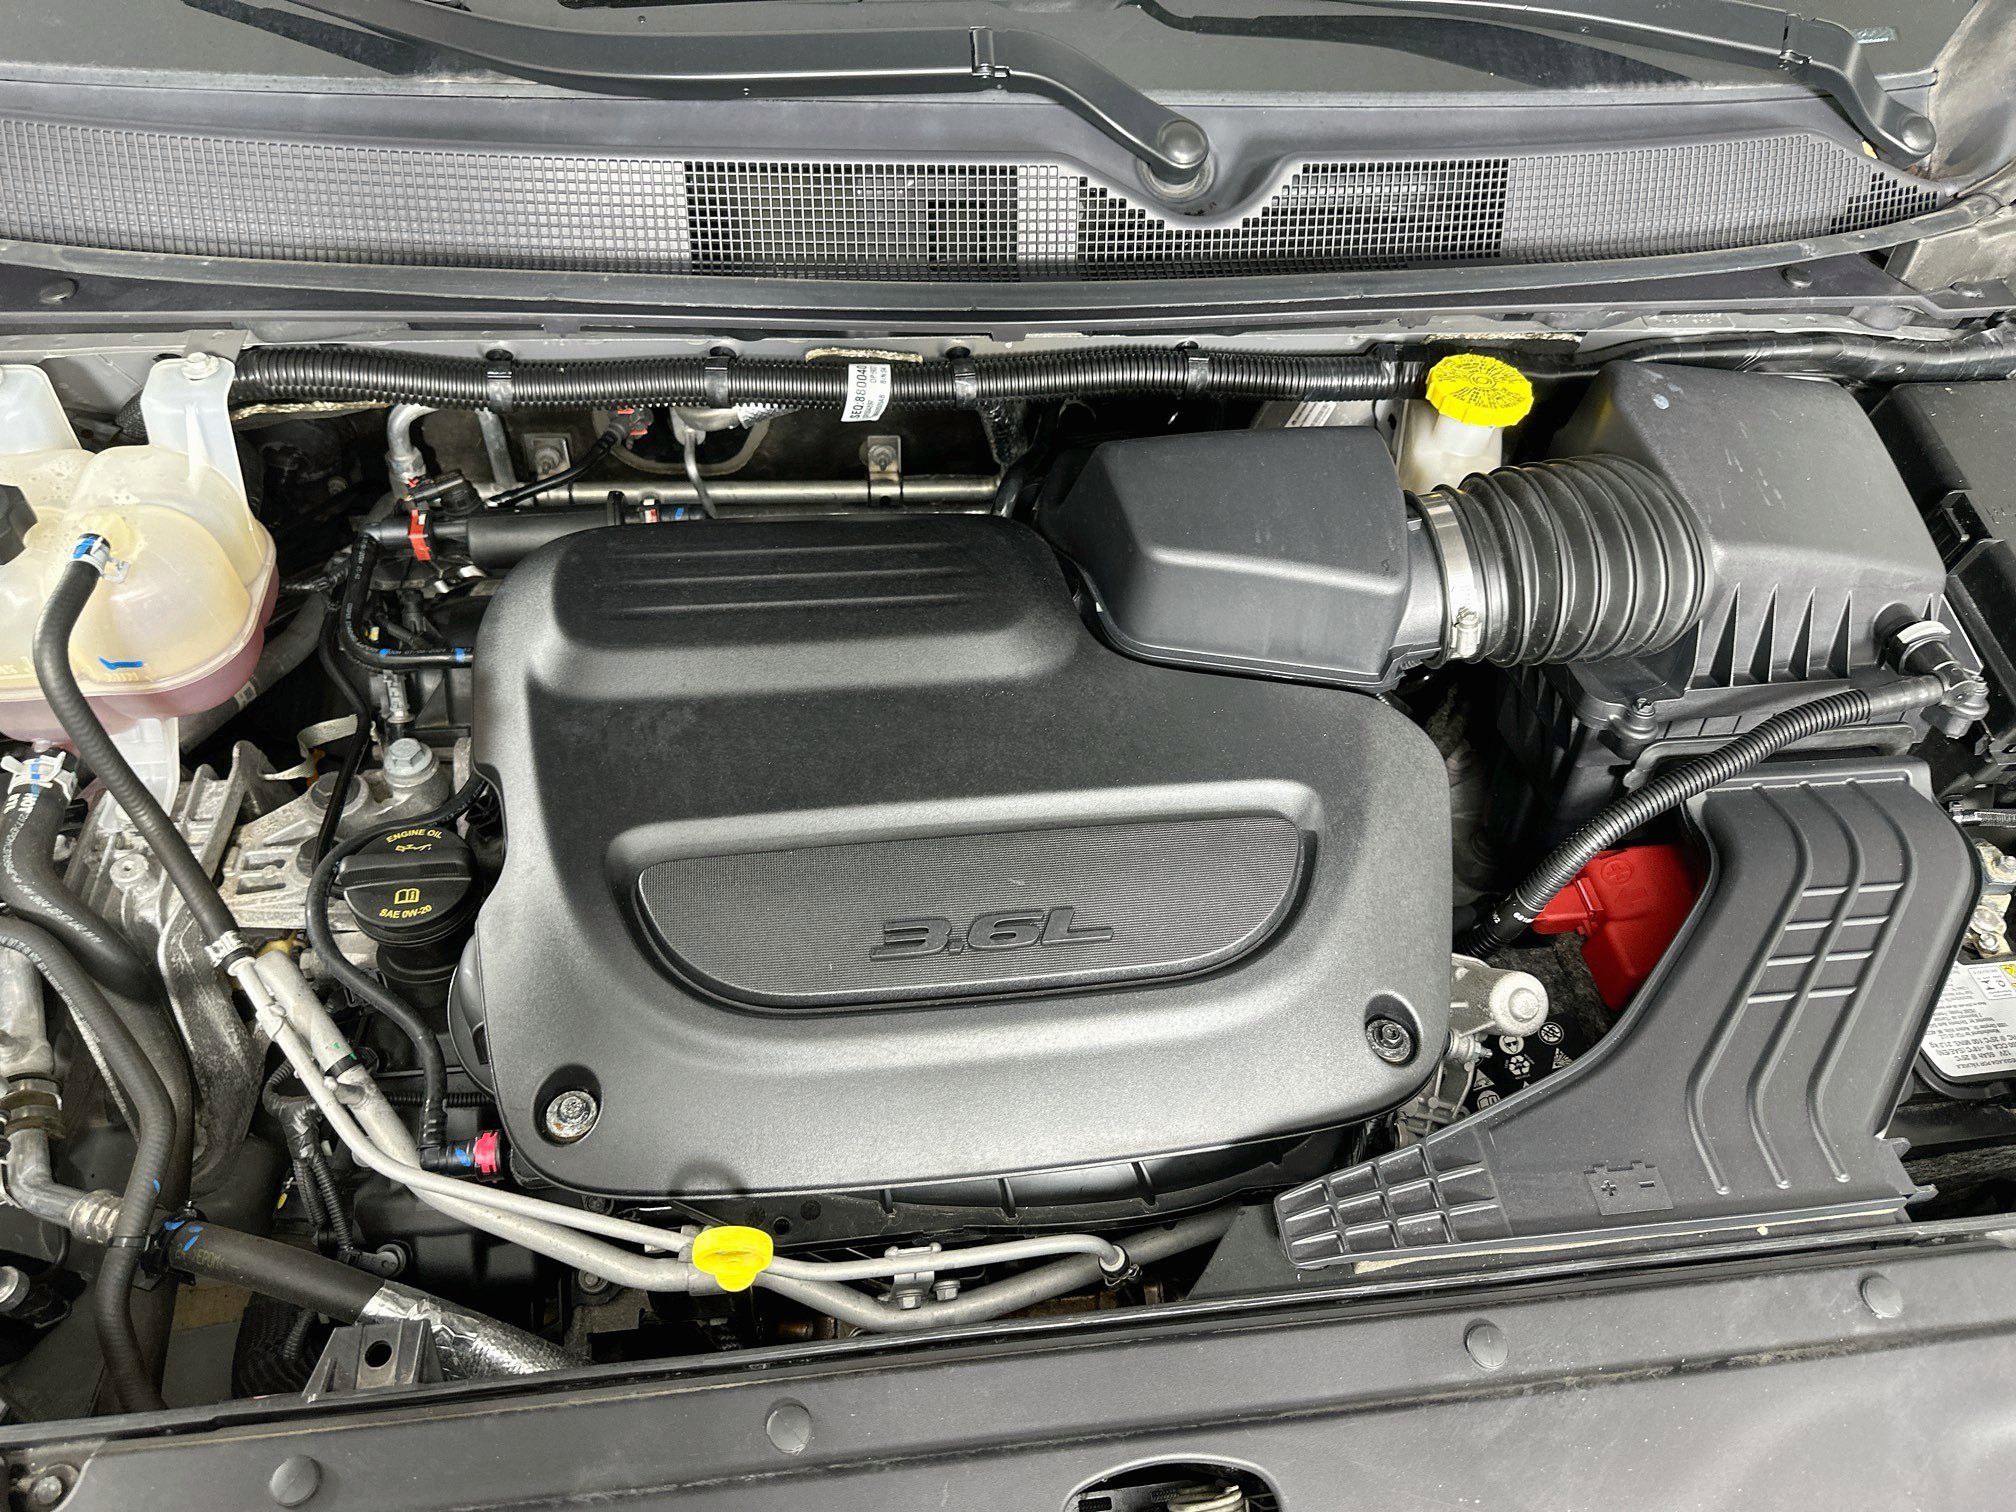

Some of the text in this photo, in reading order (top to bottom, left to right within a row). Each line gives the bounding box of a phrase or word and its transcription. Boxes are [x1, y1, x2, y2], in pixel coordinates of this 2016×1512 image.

[386, 828, 443, 843] ENGINE OIL
[379, 904, 432, 918] SAE 0W-20
[869, 907, 1114, 962] 3.6L
